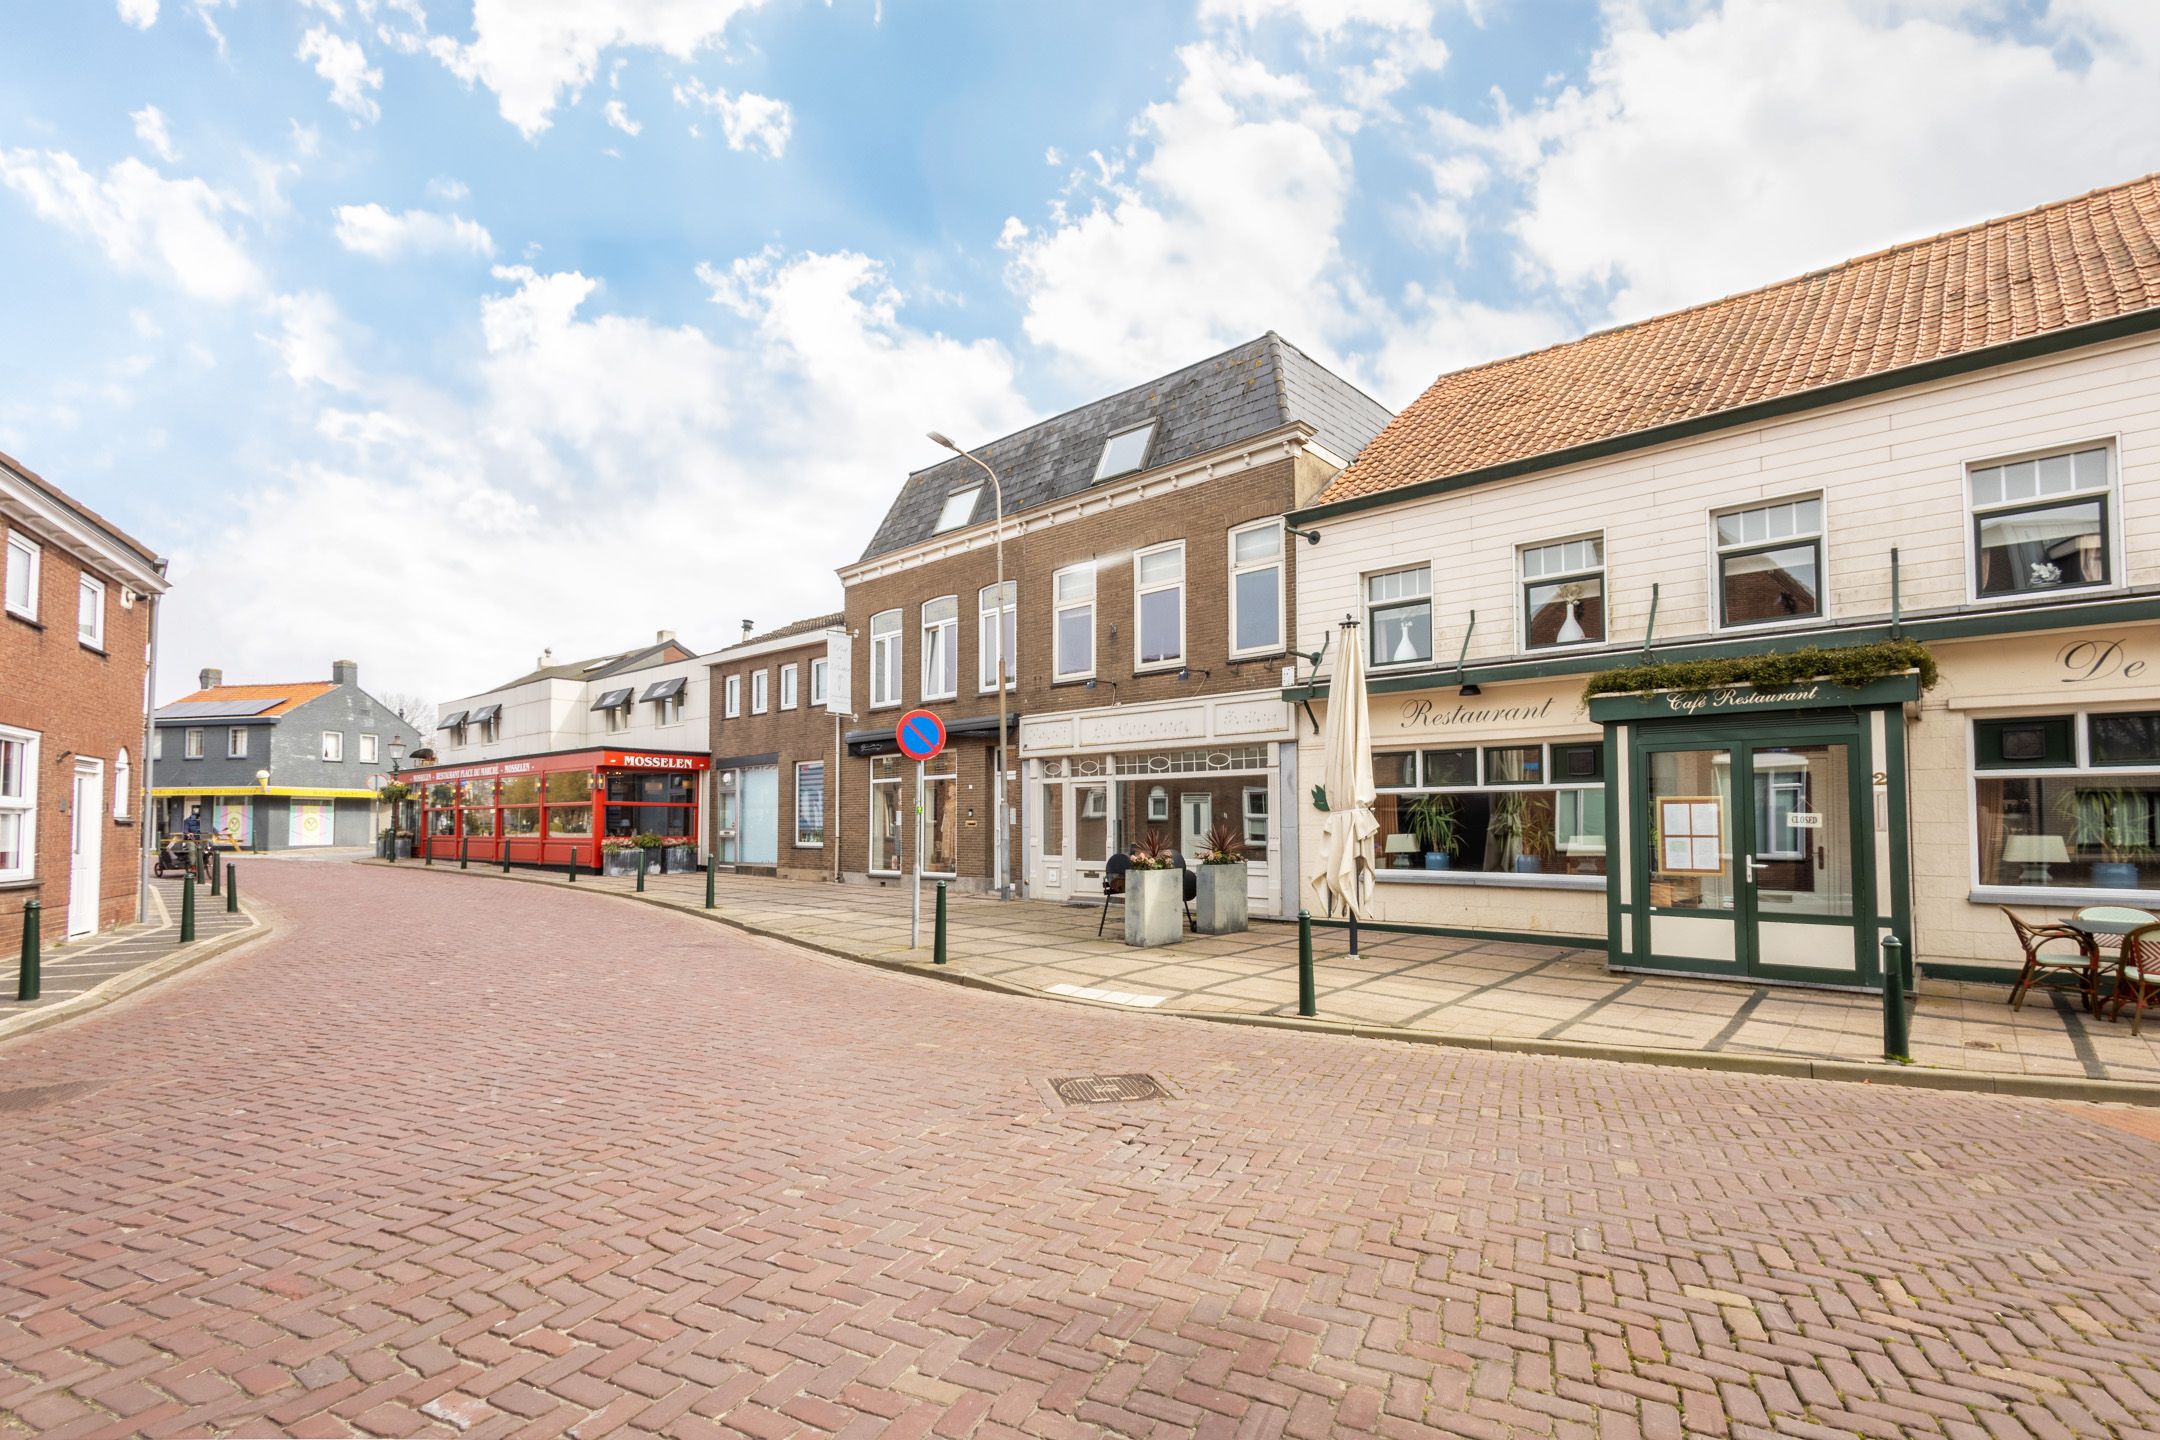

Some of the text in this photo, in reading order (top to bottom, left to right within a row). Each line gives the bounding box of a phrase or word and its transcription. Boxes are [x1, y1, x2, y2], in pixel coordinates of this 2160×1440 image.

[2055, 638, 2147, 682] De
[1666, 686, 1819, 715] Café Restaurant
[1400, 697, 1556, 729] Restaurant
[624, 755, 693, 769] MOSSELEN
[1872, 772, 1888, 786] 2
[1791, 815, 1818, 824] CLOSED
